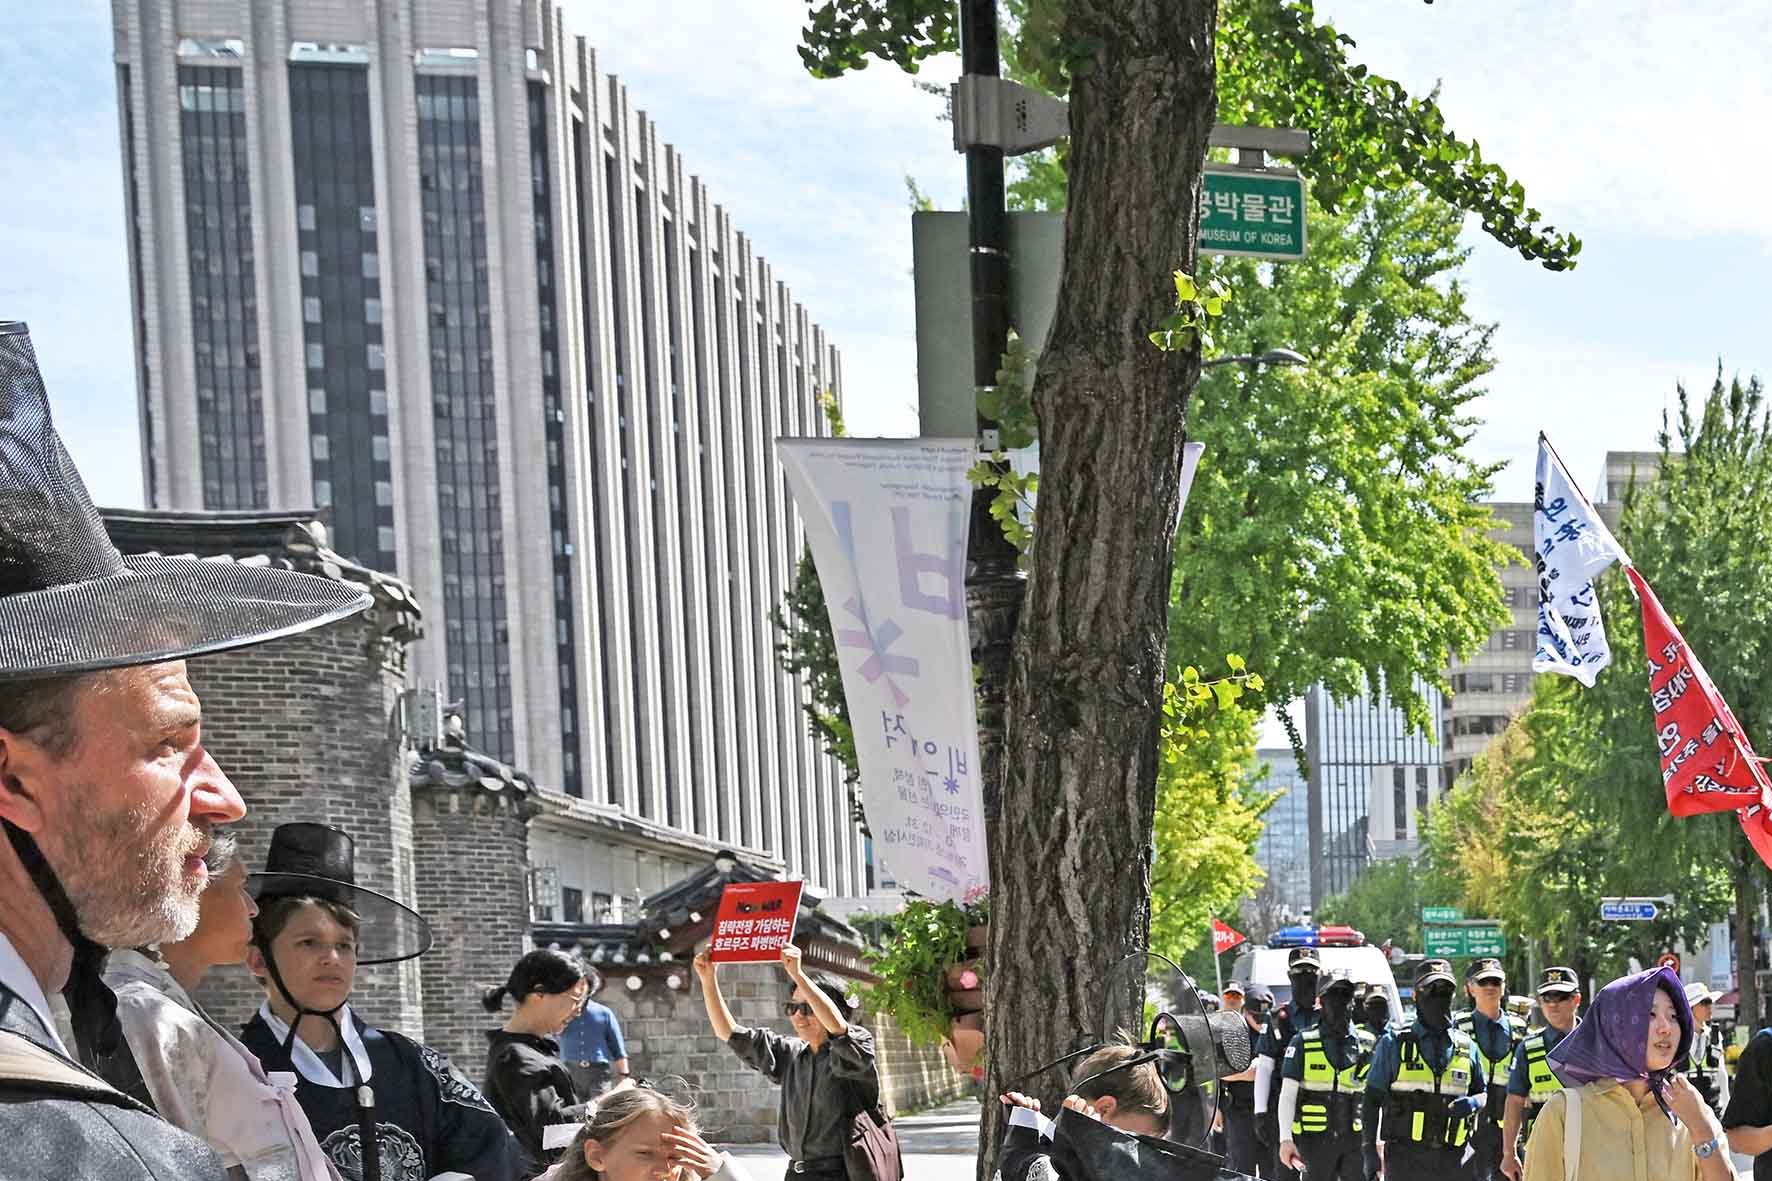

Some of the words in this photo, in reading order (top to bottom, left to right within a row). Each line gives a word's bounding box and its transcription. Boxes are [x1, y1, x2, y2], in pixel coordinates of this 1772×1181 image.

[1198, 228, 1240, 242] MUSEUM
[1243, 231, 1257, 243] OF
[1261, 232, 1293, 246] KOREA
[718, 920, 754, 935] 침략전쟁
[753, 917, 791, 934] 가담하는
[713, 937, 750, 952] 호르무즈
